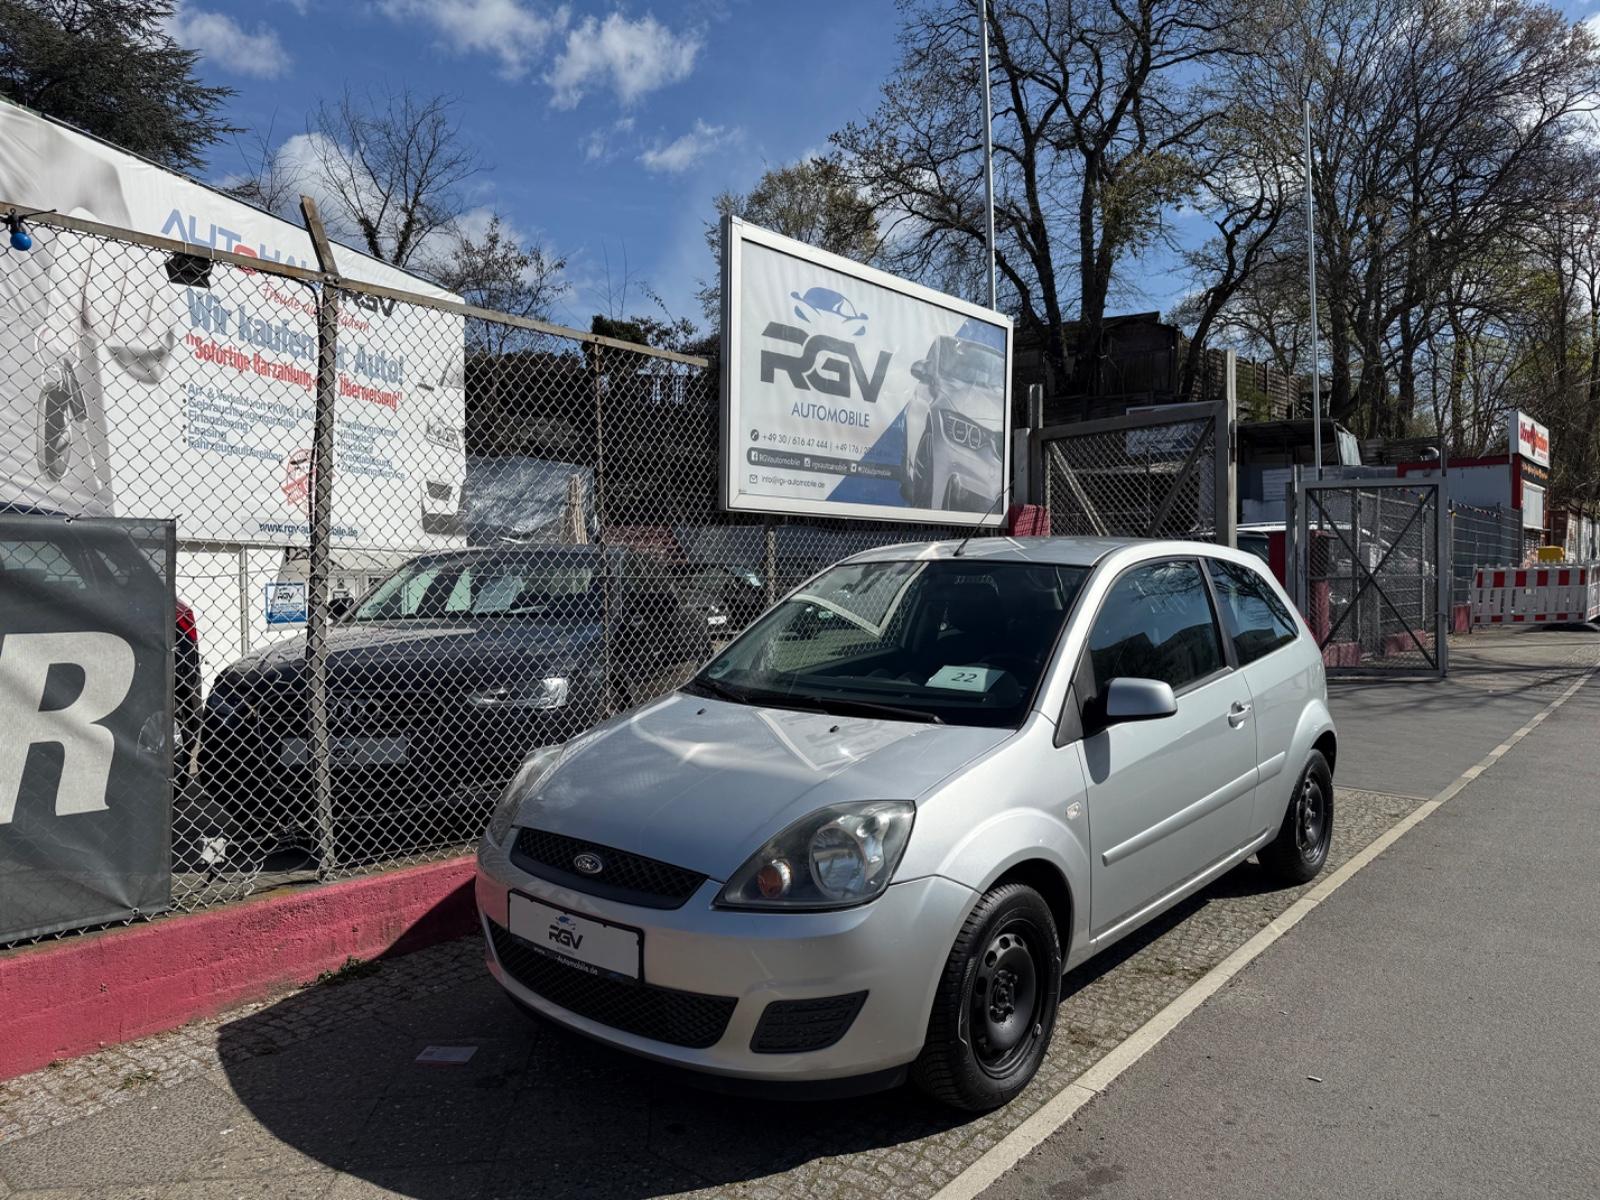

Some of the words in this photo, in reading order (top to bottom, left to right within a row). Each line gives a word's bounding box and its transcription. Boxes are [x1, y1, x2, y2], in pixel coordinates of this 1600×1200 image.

[187, 287, 232, 336] Wir
[238, 304, 316, 361] kaufen
[354, 345, 404, 386] Auto!
[252, 353, 314, 392] Barzahlung
[760, 321, 893, 404] RGV
[791, 401, 870, 428] AUTOMOBILE
[951, 671, 978, 683] 22
[548, 924, 584, 950] RGV
